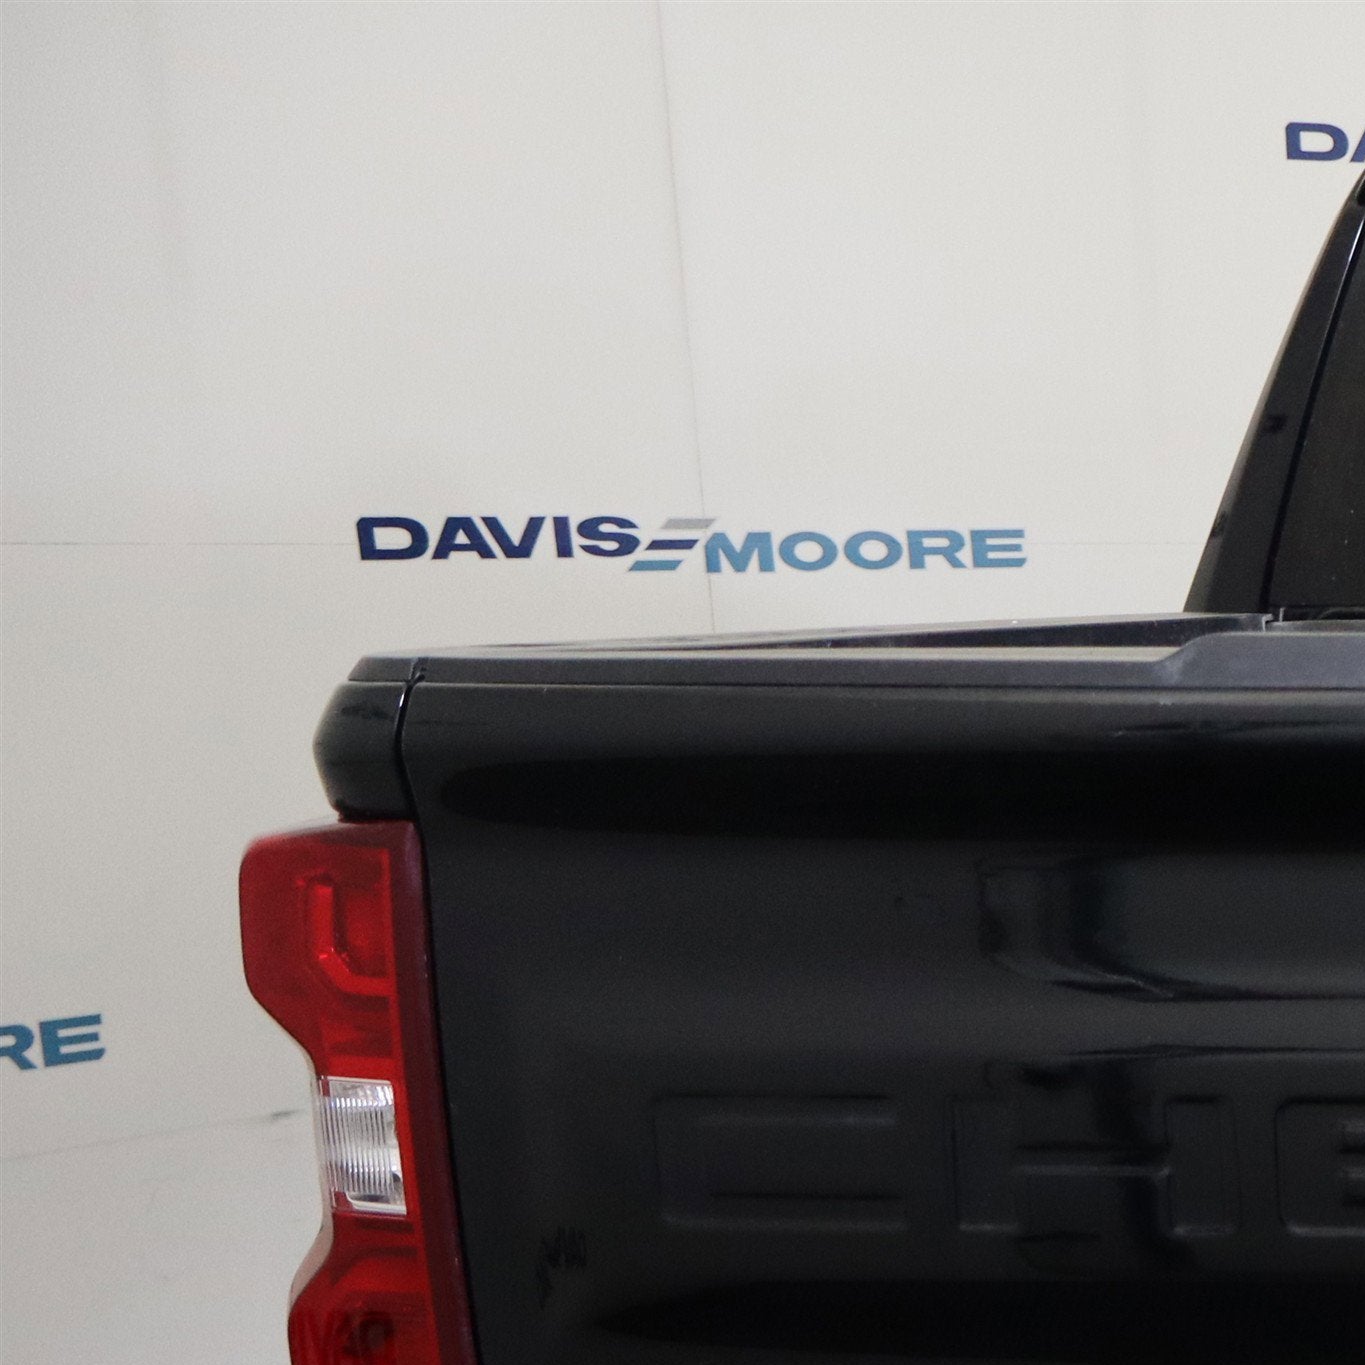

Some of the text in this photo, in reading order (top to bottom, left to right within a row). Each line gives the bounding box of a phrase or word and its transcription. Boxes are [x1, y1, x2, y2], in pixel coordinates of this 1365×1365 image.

[354, 515, 1028, 574] DAVIS MOORE
[0, 1013, 106, 1071] RE
